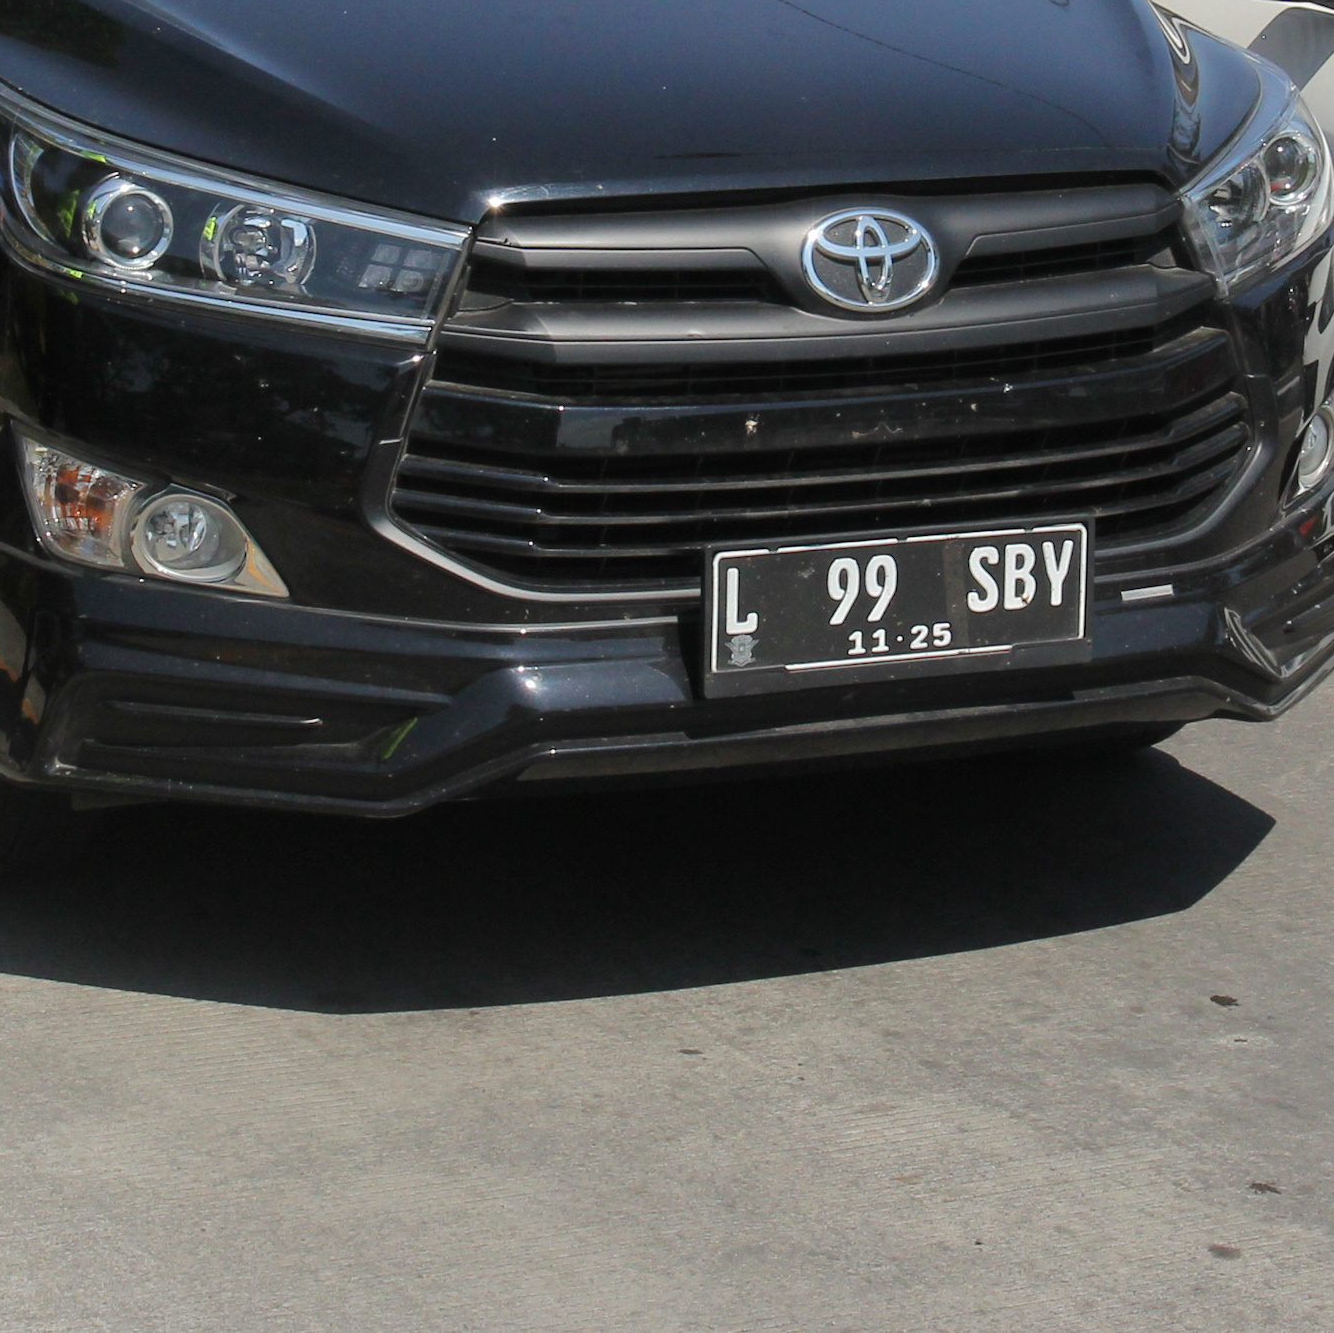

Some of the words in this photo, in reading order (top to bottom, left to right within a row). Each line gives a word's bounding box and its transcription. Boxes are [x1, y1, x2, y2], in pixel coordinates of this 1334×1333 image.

[724, 567, 759, 636] L
[826, 554, 898, 627] 99
[967, 539, 1075, 613] SBY
